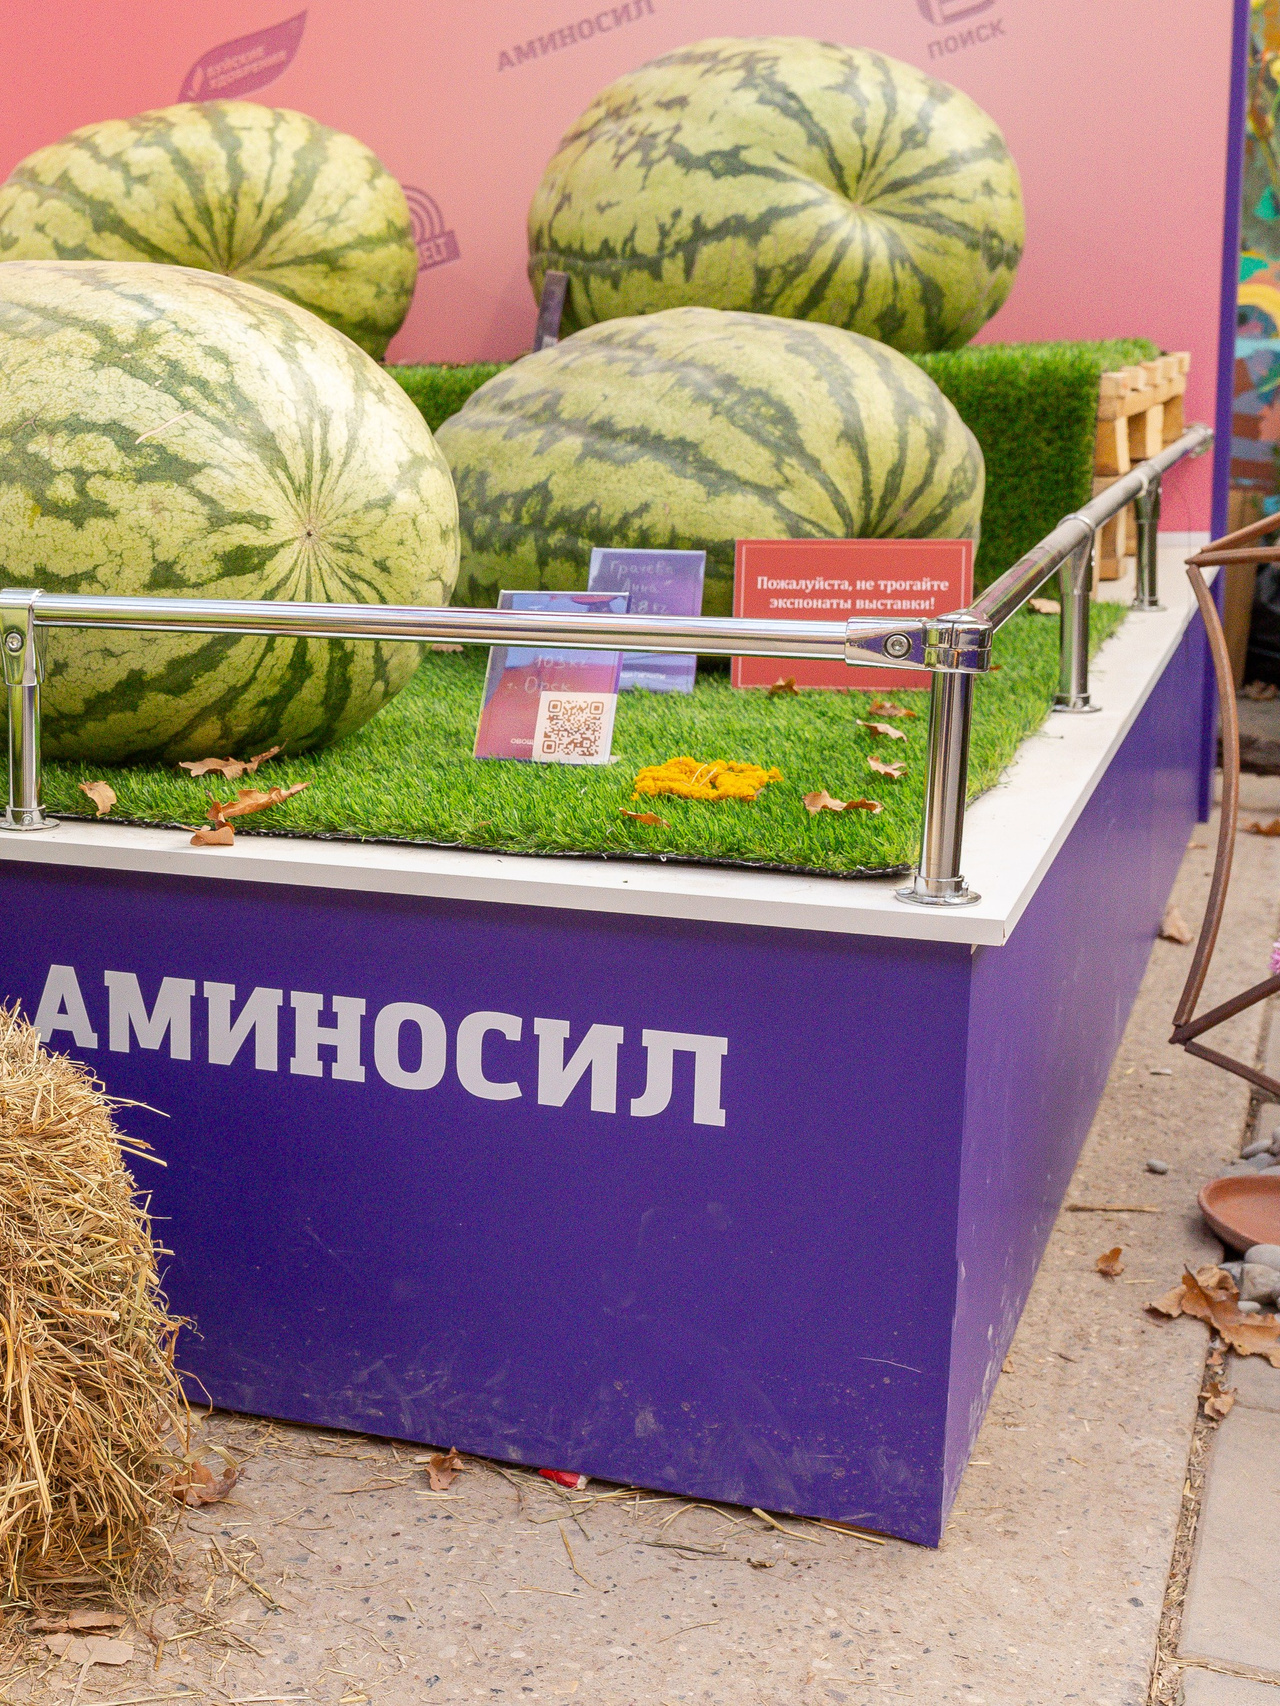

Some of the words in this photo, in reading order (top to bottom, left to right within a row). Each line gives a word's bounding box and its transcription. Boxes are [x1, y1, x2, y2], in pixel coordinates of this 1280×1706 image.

[498, 0, 655, 72] АМИНОСИЛ
[927, 17, 1005, 59] ПОИСК
[756, 576, 853, 593] Пожалуйста,
[856, 580, 875, 591] не
[878, 577, 949, 593] трогайте
[769, 597, 852, 610] экспонаты
[855, 596, 936, 610] выставки!
[534, 655, 566, 669] 103
[524, 675, 571, 694] Орск
[33, 964, 729, 1127] АМИНОСИЛ
